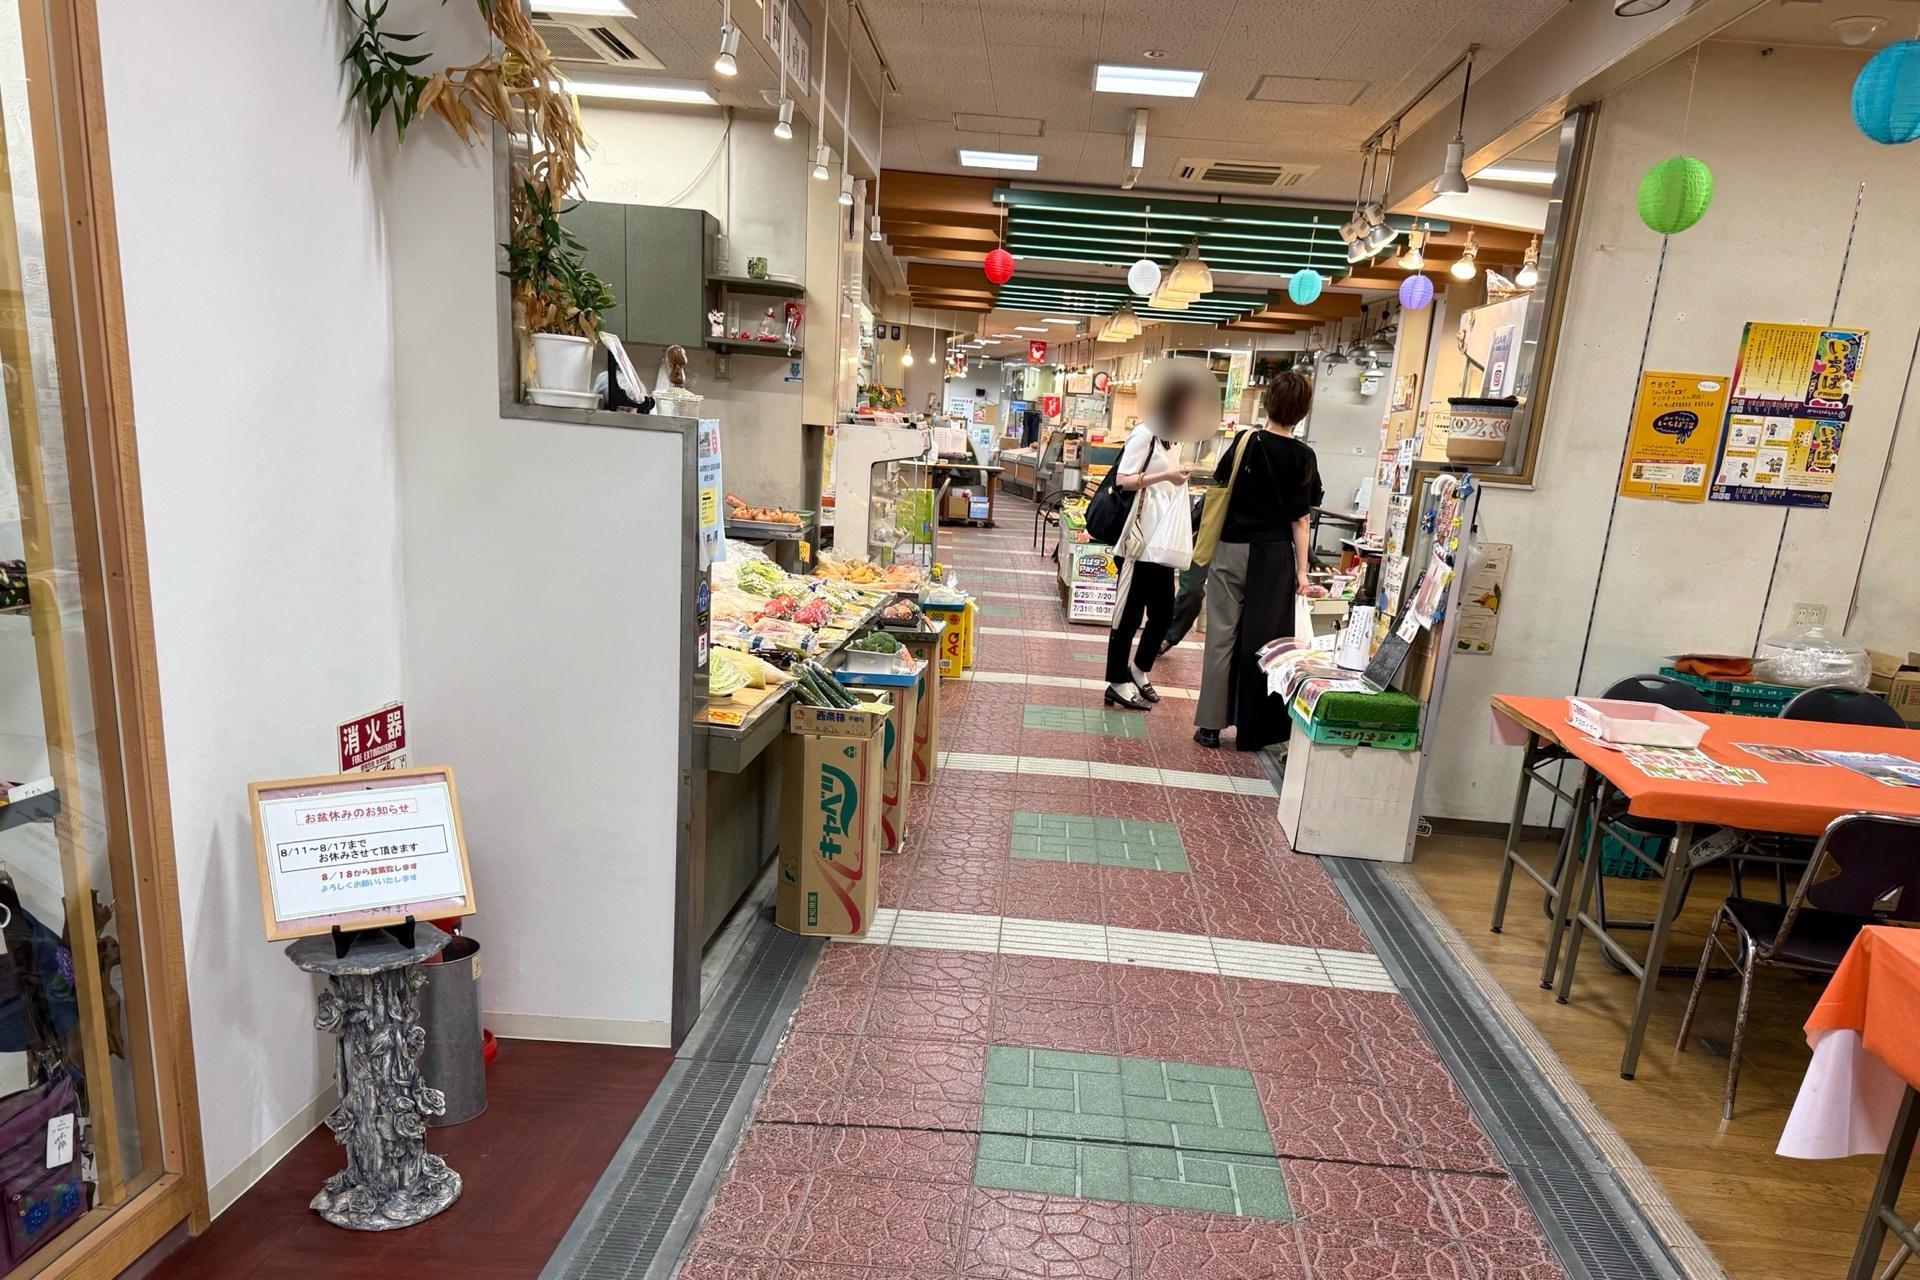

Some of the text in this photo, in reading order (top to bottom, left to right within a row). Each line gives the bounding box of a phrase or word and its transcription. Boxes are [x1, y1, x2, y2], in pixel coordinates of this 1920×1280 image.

[343, 710, 402, 757] 消火器
[351, 752, 364, 766] FIRE
[363, 741, 397, 761] EXTINGUISHER
[305, 803, 410, 824] お盆休みのお知らせ
[819, 762, 858, 861] キャベツ
[318, 843, 418, 863] お休みさせて頂きます
[320, 874, 417, 893] よろしくお願いいたします
